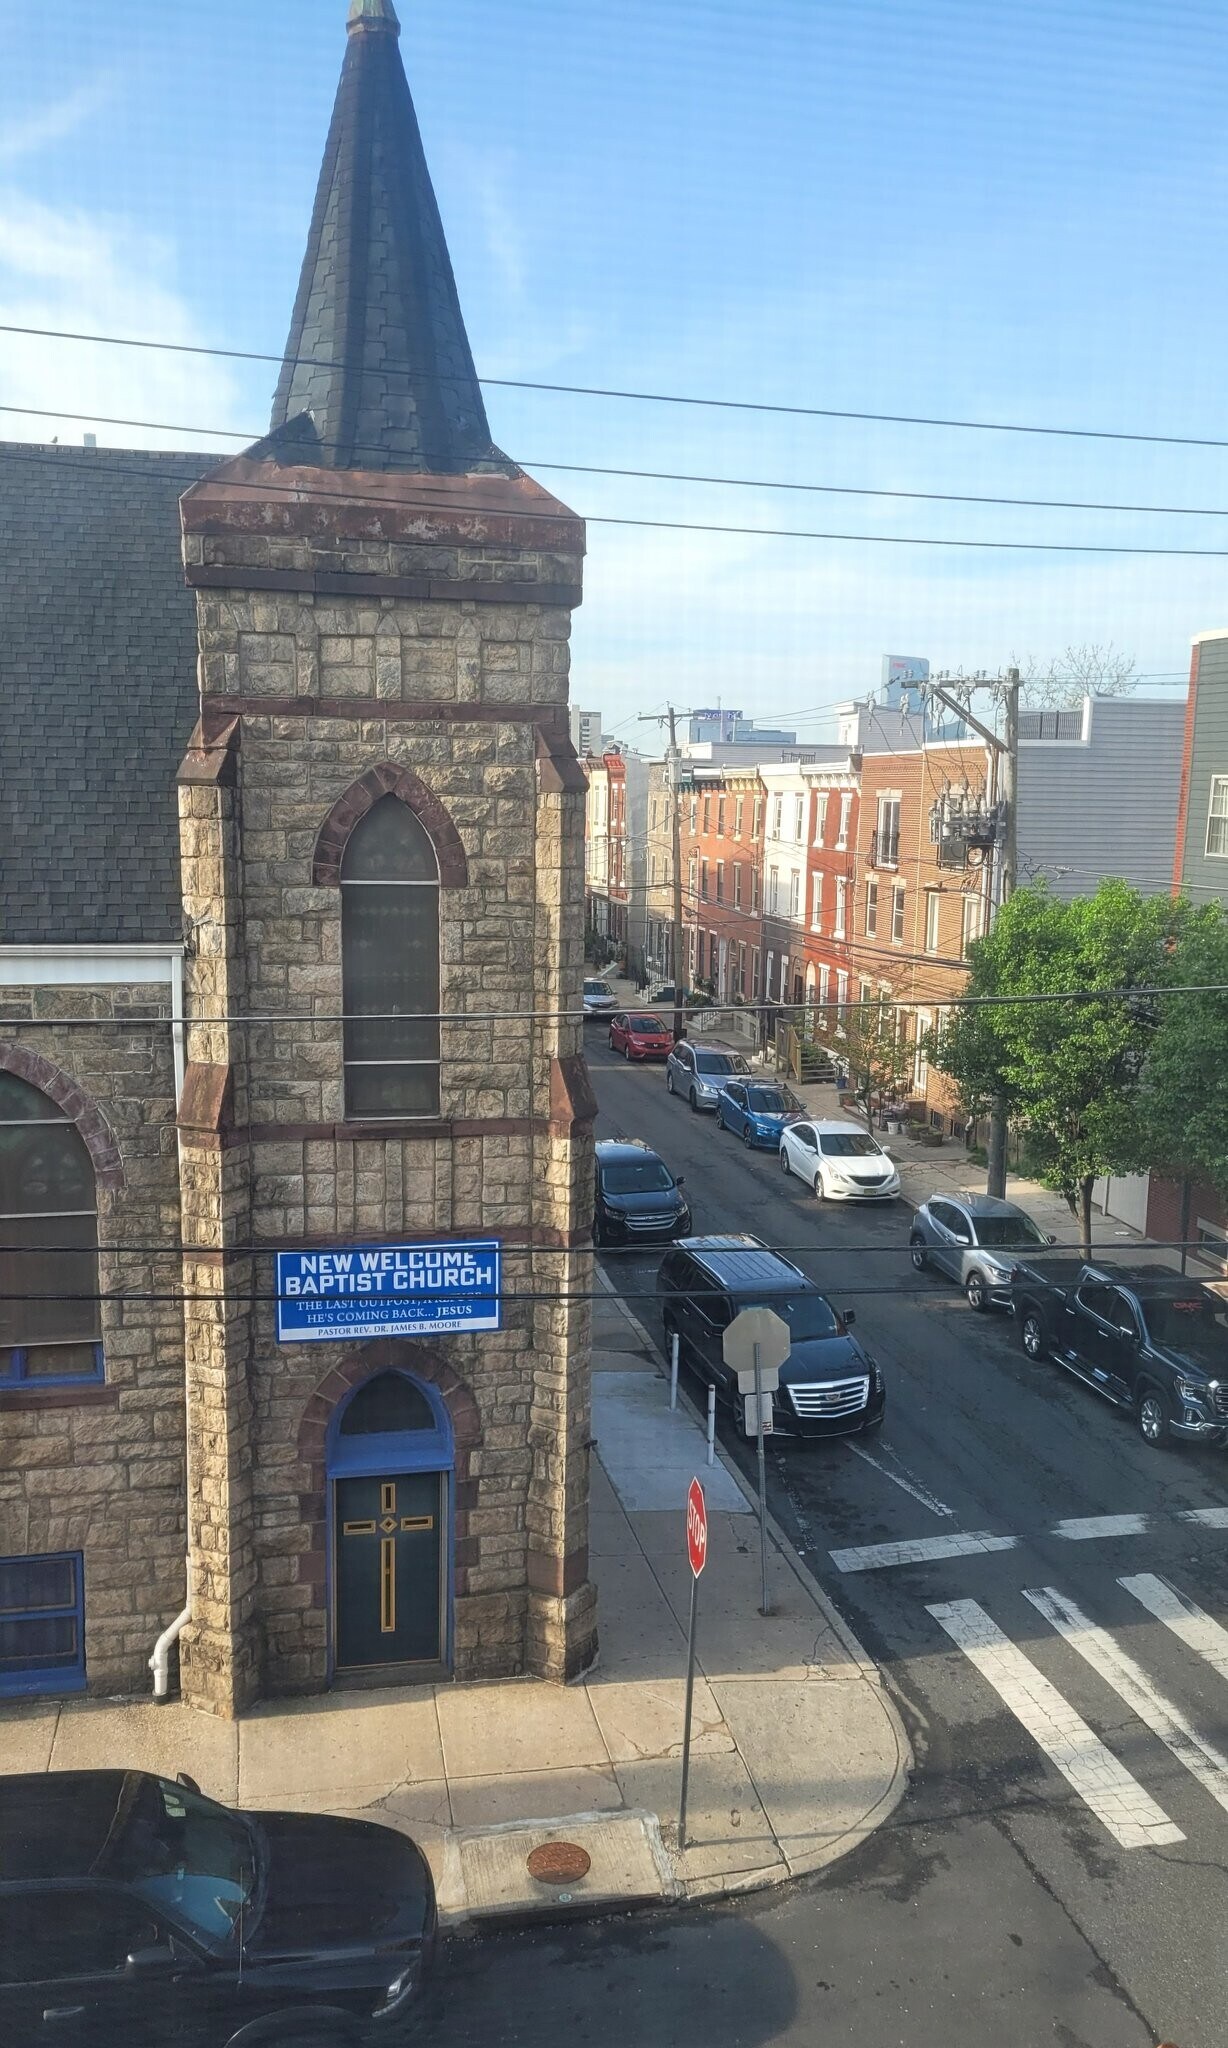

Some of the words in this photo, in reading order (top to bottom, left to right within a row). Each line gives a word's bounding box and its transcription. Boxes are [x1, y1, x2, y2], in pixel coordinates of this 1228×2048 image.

[301, 1255, 353, 1275] NEW
[359, 1252, 477, 1272] WELCOME
[285, 1272, 386, 1296] BAPTIST
[393, 1266, 492, 1290] CHURCH
[296, 1300, 323, 1311] THE
[326, 1299, 356, 1310] LAST
[306, 1312, 334, 1324] HE'S
[336, 1310, 389, 1322] COMING
[392, 1307, 434, 1319] BACK...
[435, 1305, 472, 1319] JESUS
[318, 1327, 351, 1336] PASTOR
[353, 1326, 372, 1334] REV.
[374, 1325, 388, 1333] DR.
[390, 1323, 417, 1333] JAMES
[419, 1322, 427, 1331] B.
[429, 1320, 462, 1330] MOORE
[688, 1498, 705, 1553] STOP
